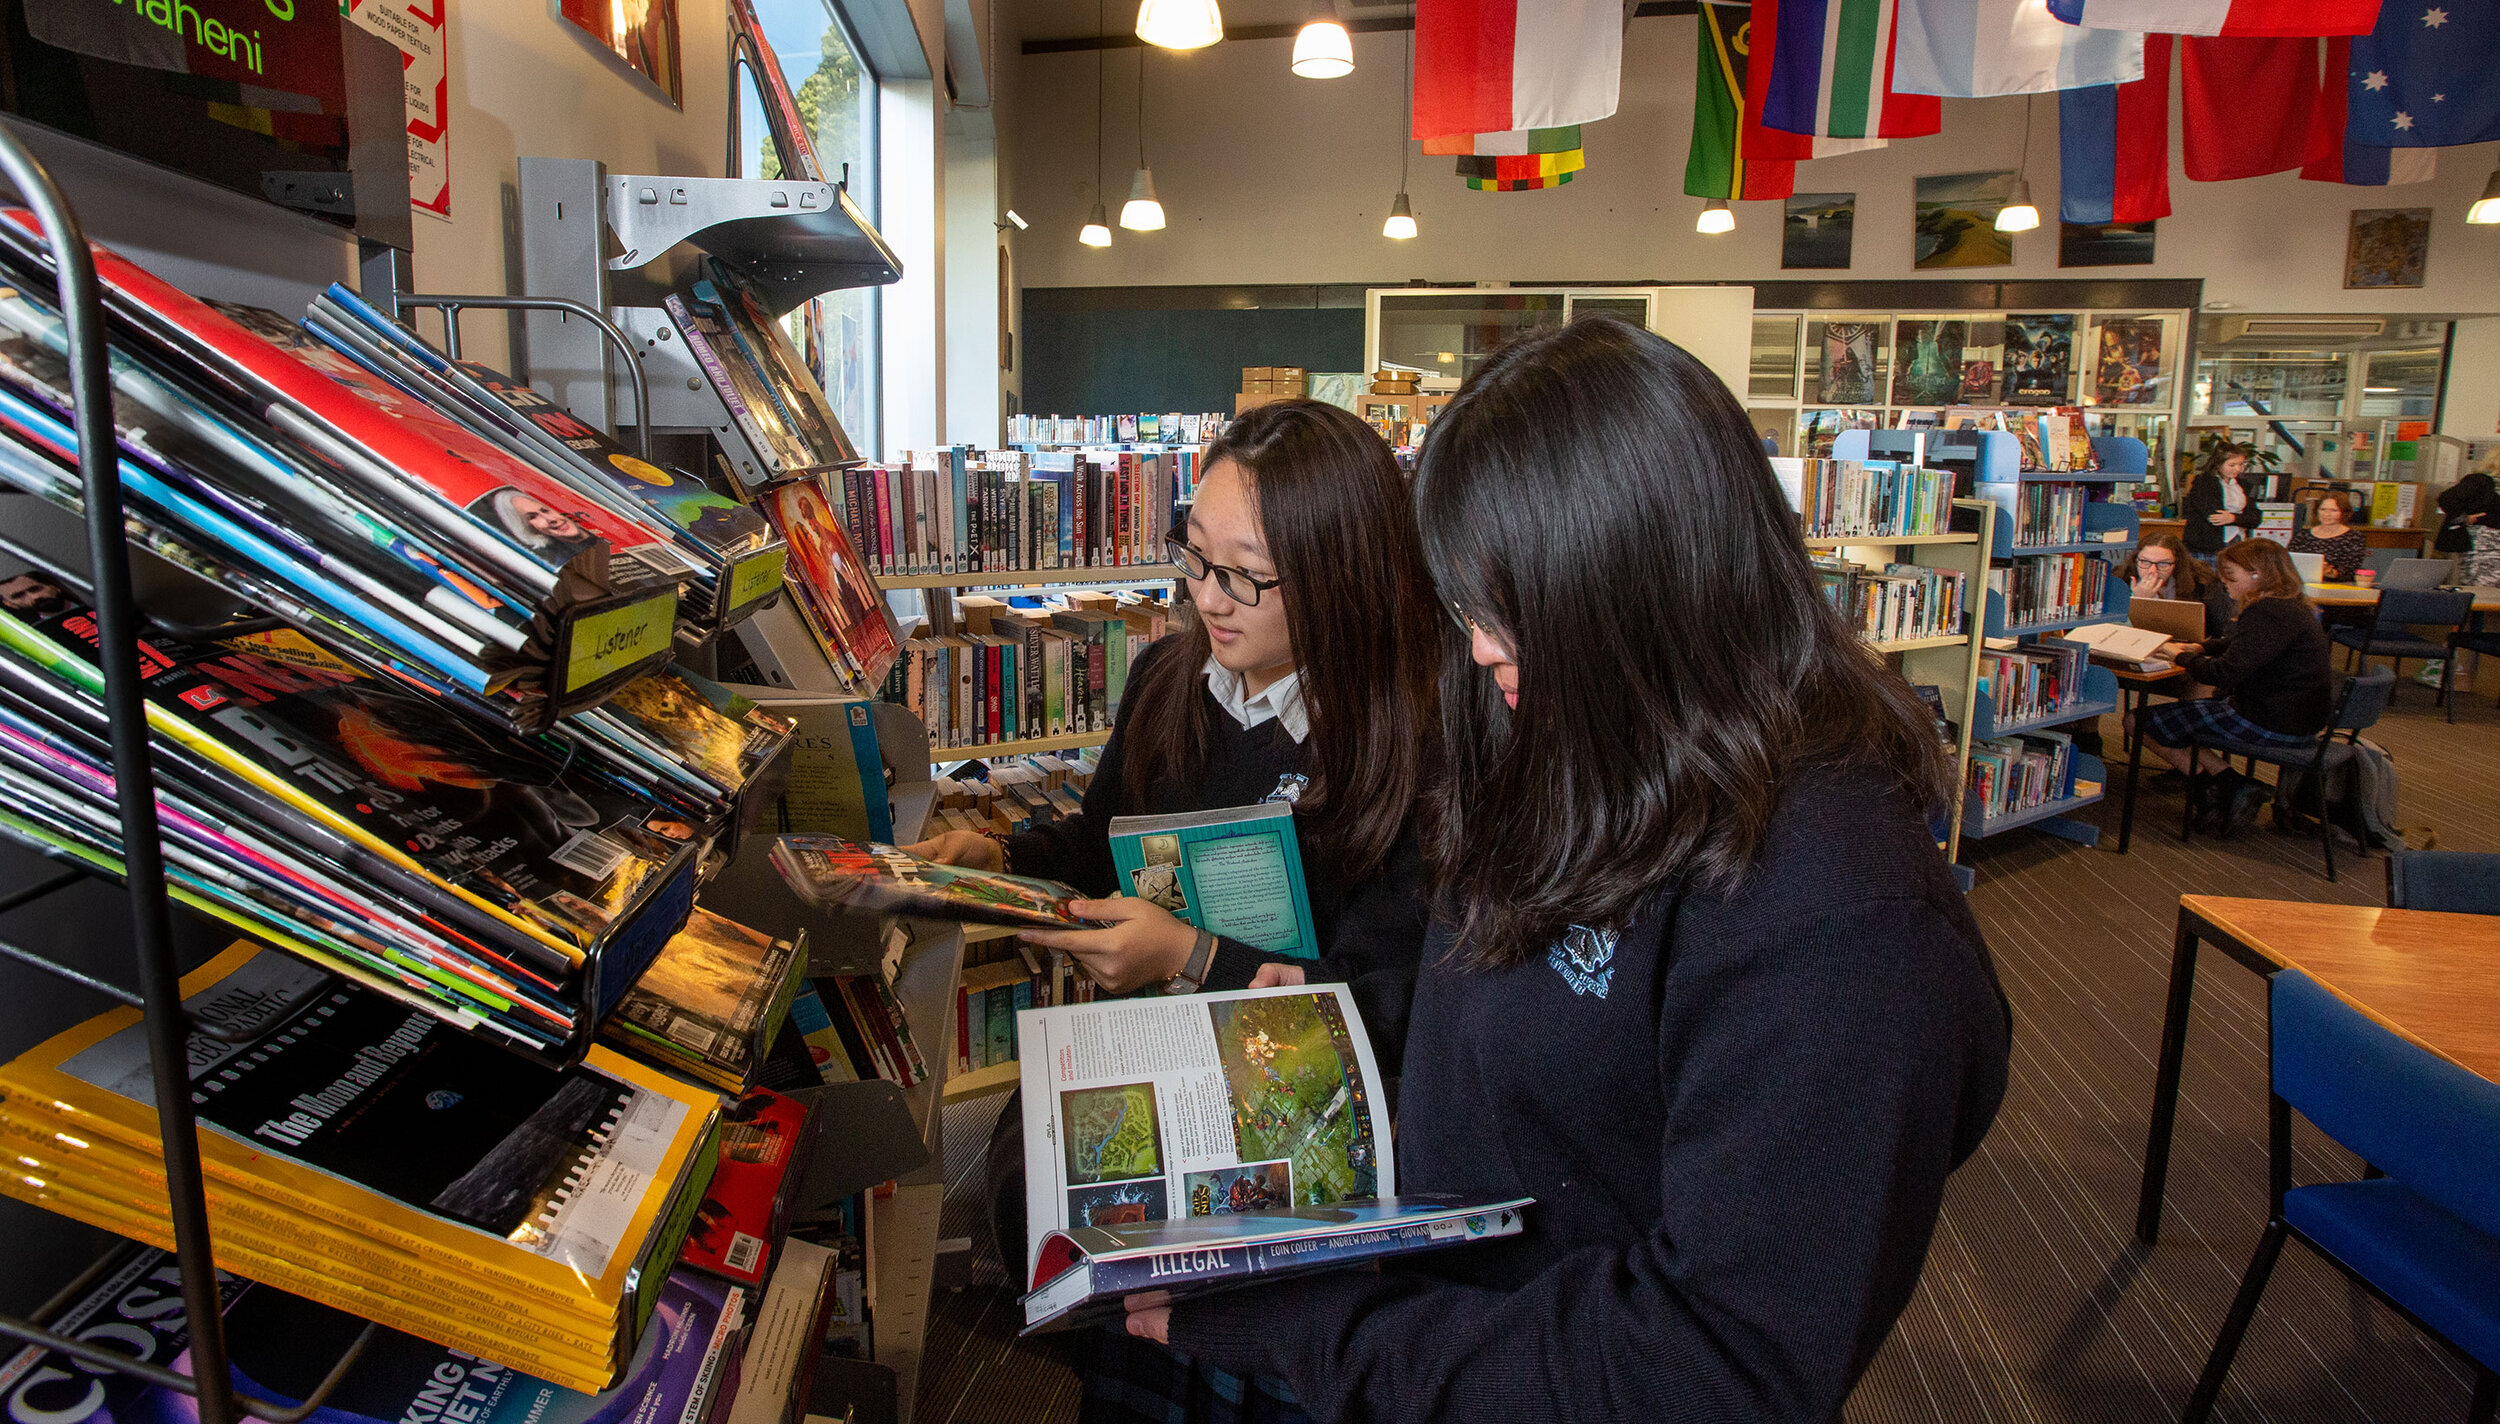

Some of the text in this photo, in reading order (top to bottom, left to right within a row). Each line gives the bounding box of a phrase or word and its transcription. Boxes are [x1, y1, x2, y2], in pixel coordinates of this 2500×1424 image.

[366, 10, 431, 55] WOOD PAPER TEXTILES
[379, 4, 419, 34] SUITABLE FOR
[409, 96, 429, 114] LIQUIDS
[410, 84, 421, 97] FOR
[409, 150, 435, 168] LECTRICAL
[412, 138, 423, 150] FOR
[690, 333, 742, 411] ROMEO AND JULIET
[1119, 461, 1129, 481] LAST
[848, 488, 859, 530] MICHAEL
[1076, 483, 1084, 506] Across
[969, 523, 978, 543] POET
[1075, 521, 1083, 534] Sun
[1119, 508, 1129, 532] TOWER
[969, 544, 979, 556] X
[742, 567, 772, 593] Listener
[594, 623, 648, 661] Listener
[1029, 629, 1040, 690] SILVER WATTLE
[1074, 668, 1088, 704] Heaven
[362, 1009, 441, 1065] Beyond
[353, 1047, 392, 1088] and
[1058, 1048, 1067, 1082] Competitors
[1065, 1045, 1073, 1068] Imitators
[290, 1078, 358, 1120] Moon
[254, 1110, 322, 1147] The
[254, 1182, 306, 1207] PROTECTING
[307, 1201, 344, 1222] PRISTINE
[346, 1214, 368, 1230] SEAS
[378, 1226, 401, 1242] NIGER
[402, 1237, 415, 1248] AT
[423, 1244, 473, 1269] CROSSROADS
[483, 1266, 526, 1288] VANISHING
[528, 1280, 575, 1305] MANGROVES
[1270, 1244, 1290, 1258] EOIN
[1290, 1240, 1318, 1255] COLFER
[1328, 1235, 1360, 1250] ANDREW
[1361, 1232, 1390, 1246] DONKIN
[122, 1266, 140, 1287] NEW
[265, 1212, 299, 1232] PLASTIC
[309, 1230, 358, 1254] GORONGOSA
[360, 1249, 400, 1270] NATIONAL
[402, 1263, 424, 1276] PARK
[432, 1274, 495, 1303] SMOKEJUMPERS
[504, 1302, 530, 1316] EBOLA
[1150, 1249, 1230, 1279] ILLEGAL
[220, 1246, 248, 1260] CHILD
[250, 1256, 293, 1276] SACRIFICE
[301, 1274, 338, 1292] LITHIUM
[340, 1286, 363, 1300] GOLD
[394, 1304, 424, 1320] SILICON
[426, 1316, 458, 1335] VALLEY
[466, 1330, 510, 1352] KANGAROO
[512, 1346, 541, 1362] DEBATE
[233, 1232, 276, 1252] SALVADOR
[279, 1247, 318, 1266] VIOLENCE
[330, 1264, 362, 1280] BORNEO
[364, 1275, 390, 1291] CAVES
[400, 1288, 456, 1314] TREEHOPPERS
[464, 1312, 504, 1331] CARNIVAL
[506, 1326, 539, 1343] RITUALS
[328, 1248, 365, 1268] WALKING
[366, 1262, 392, 1276] TOKYO
[402, 1274, 452, 1299] RETHINKING
[452, 1294, 508, 1322] COMMUNITIES
[524, 1320, 541, 1332] CITY
[542, 1328, 564, 1342] RISES
[572, 1338, 594, 1352] RATS
[252, 1269, 294, 1289] TARGETED
[298, 1285, 319, 1297] CARE
[412, 1324, 445, 1344] CHINESE
[449, 1337, 488, 1358] REMEDIES
[497, 1354, 544, 1376] CHILDBIRTH
[545, 1371, 576, 1386] DEATHS
[663, 1328, 680, 1360] HADRON
[675, 1312, 696, 1354] Inside CERN
[685, 1291, 742, 1422] STEM OF SKIING MICRO PHOTOS
[399, 1361, 466, 1424] KING
[482, 1370, 515, 1419] OF EARTHLY
[639, 1380, 658, 1413] SCIENCE
